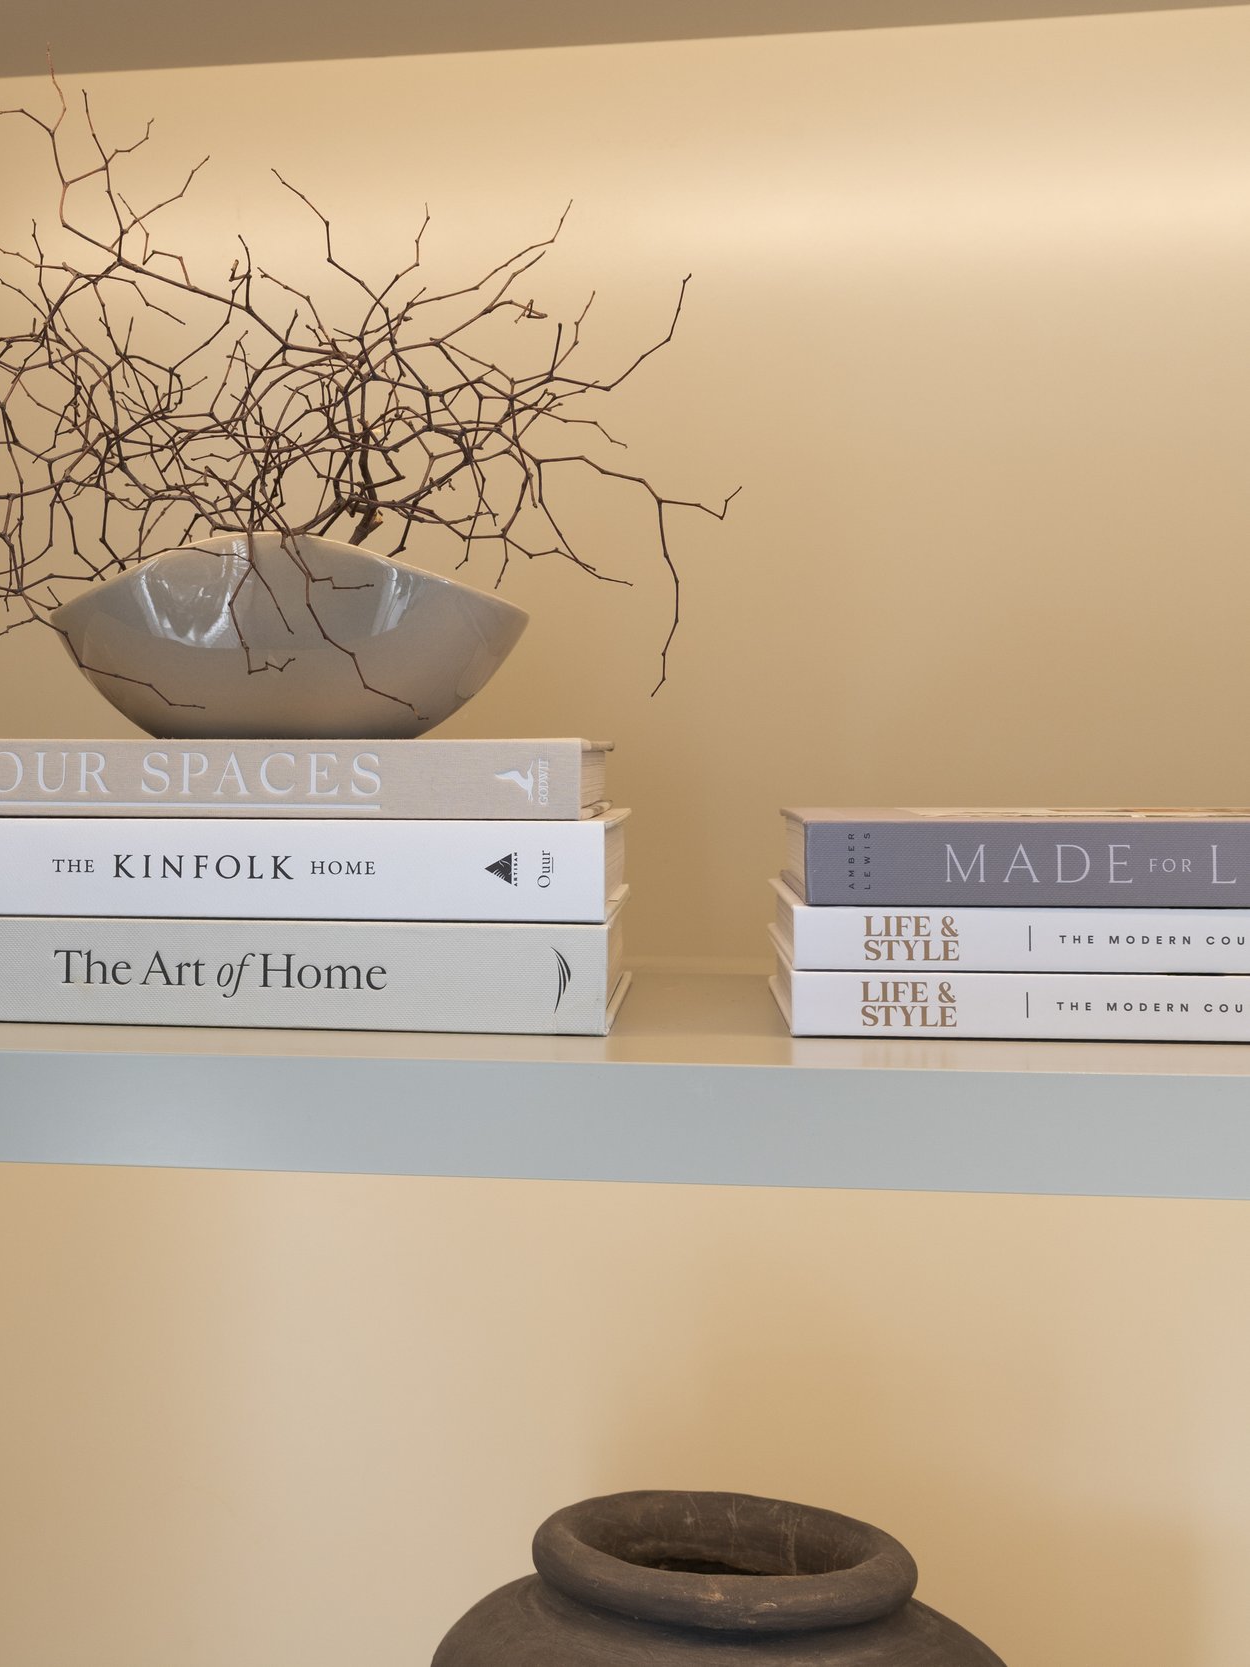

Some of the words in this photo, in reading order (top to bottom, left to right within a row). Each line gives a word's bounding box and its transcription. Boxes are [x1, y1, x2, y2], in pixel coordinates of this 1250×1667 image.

[140, 751, 383, 796] SPACES
[537, 758, 549, 805] GODWIT
[53, 858, 95, 873] THE
[113, 854, 295, 880] KINFOLK
[310, 860, 377, 876] HOME
[537, 850, 551, 888] Ouur
[863, 832, 871, 889] LEWIS
[945, 842, 1134, 884] MADE
[1149, 858, 1192, 873] FOR
[1211, 844, 1237, 884] L
[863, 915, 931, 937] LIFE
[940, 915, 959, 938] &
[863, 939, 960, 961] STYLE
[1059, 935, 1095, 944] THE
[1109, 935, 1191, 945] MODERN
[1205, 936, 1246, 946] COU
[53, 949, 132, 985] The
[140, 950, 206, 987] Art
[216, 953, 256, 998] of
[259, 953, 388, 991] Home
[861, 981, 928, 1003] LIFE
[937, 981, 957, 1003] &
[861, 1005, 958, 1027] STYLE
[1057, 1001, 1092, 1011] THE
[1107, 1002, 1189, 1012] MODERN
[1203, 1003, 1243, 1013] COU
